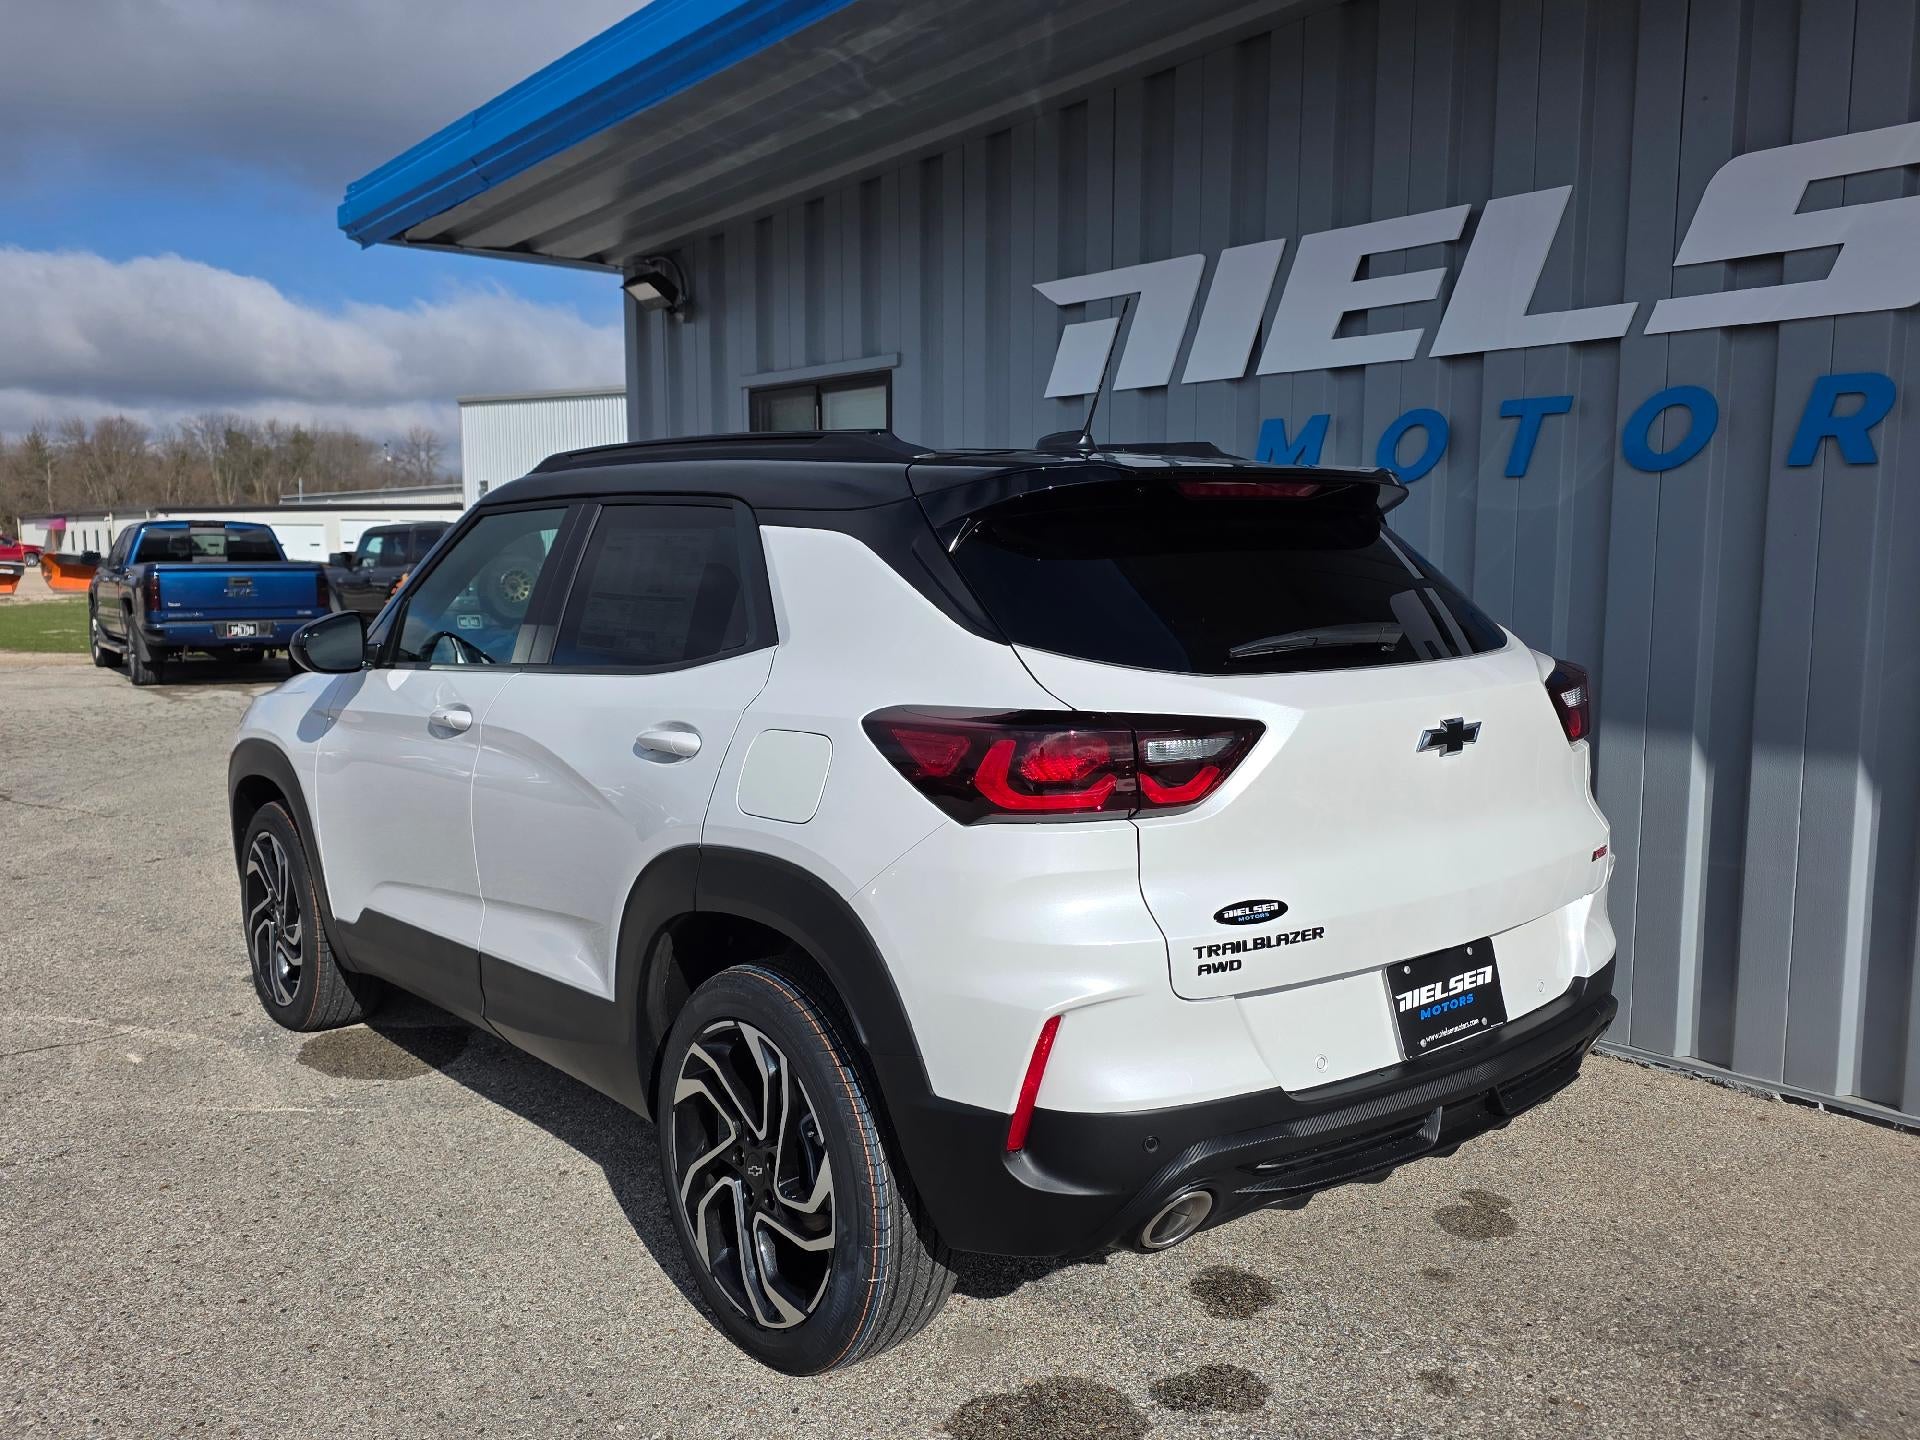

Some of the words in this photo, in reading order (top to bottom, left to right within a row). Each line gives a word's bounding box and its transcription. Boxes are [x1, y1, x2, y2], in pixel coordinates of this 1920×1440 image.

[1222, 902, 1279, 918] NIELSEN
[1238, 912, 1270, 922] MOTORS
[1193, 926, 1325, 959] TRAILBLAZER
[1197, 959, 1242, 976] AWD
[1395, 965, 1493, 1013] NIELSEN
[1420, 993, 1474, 1020] MOTORS
